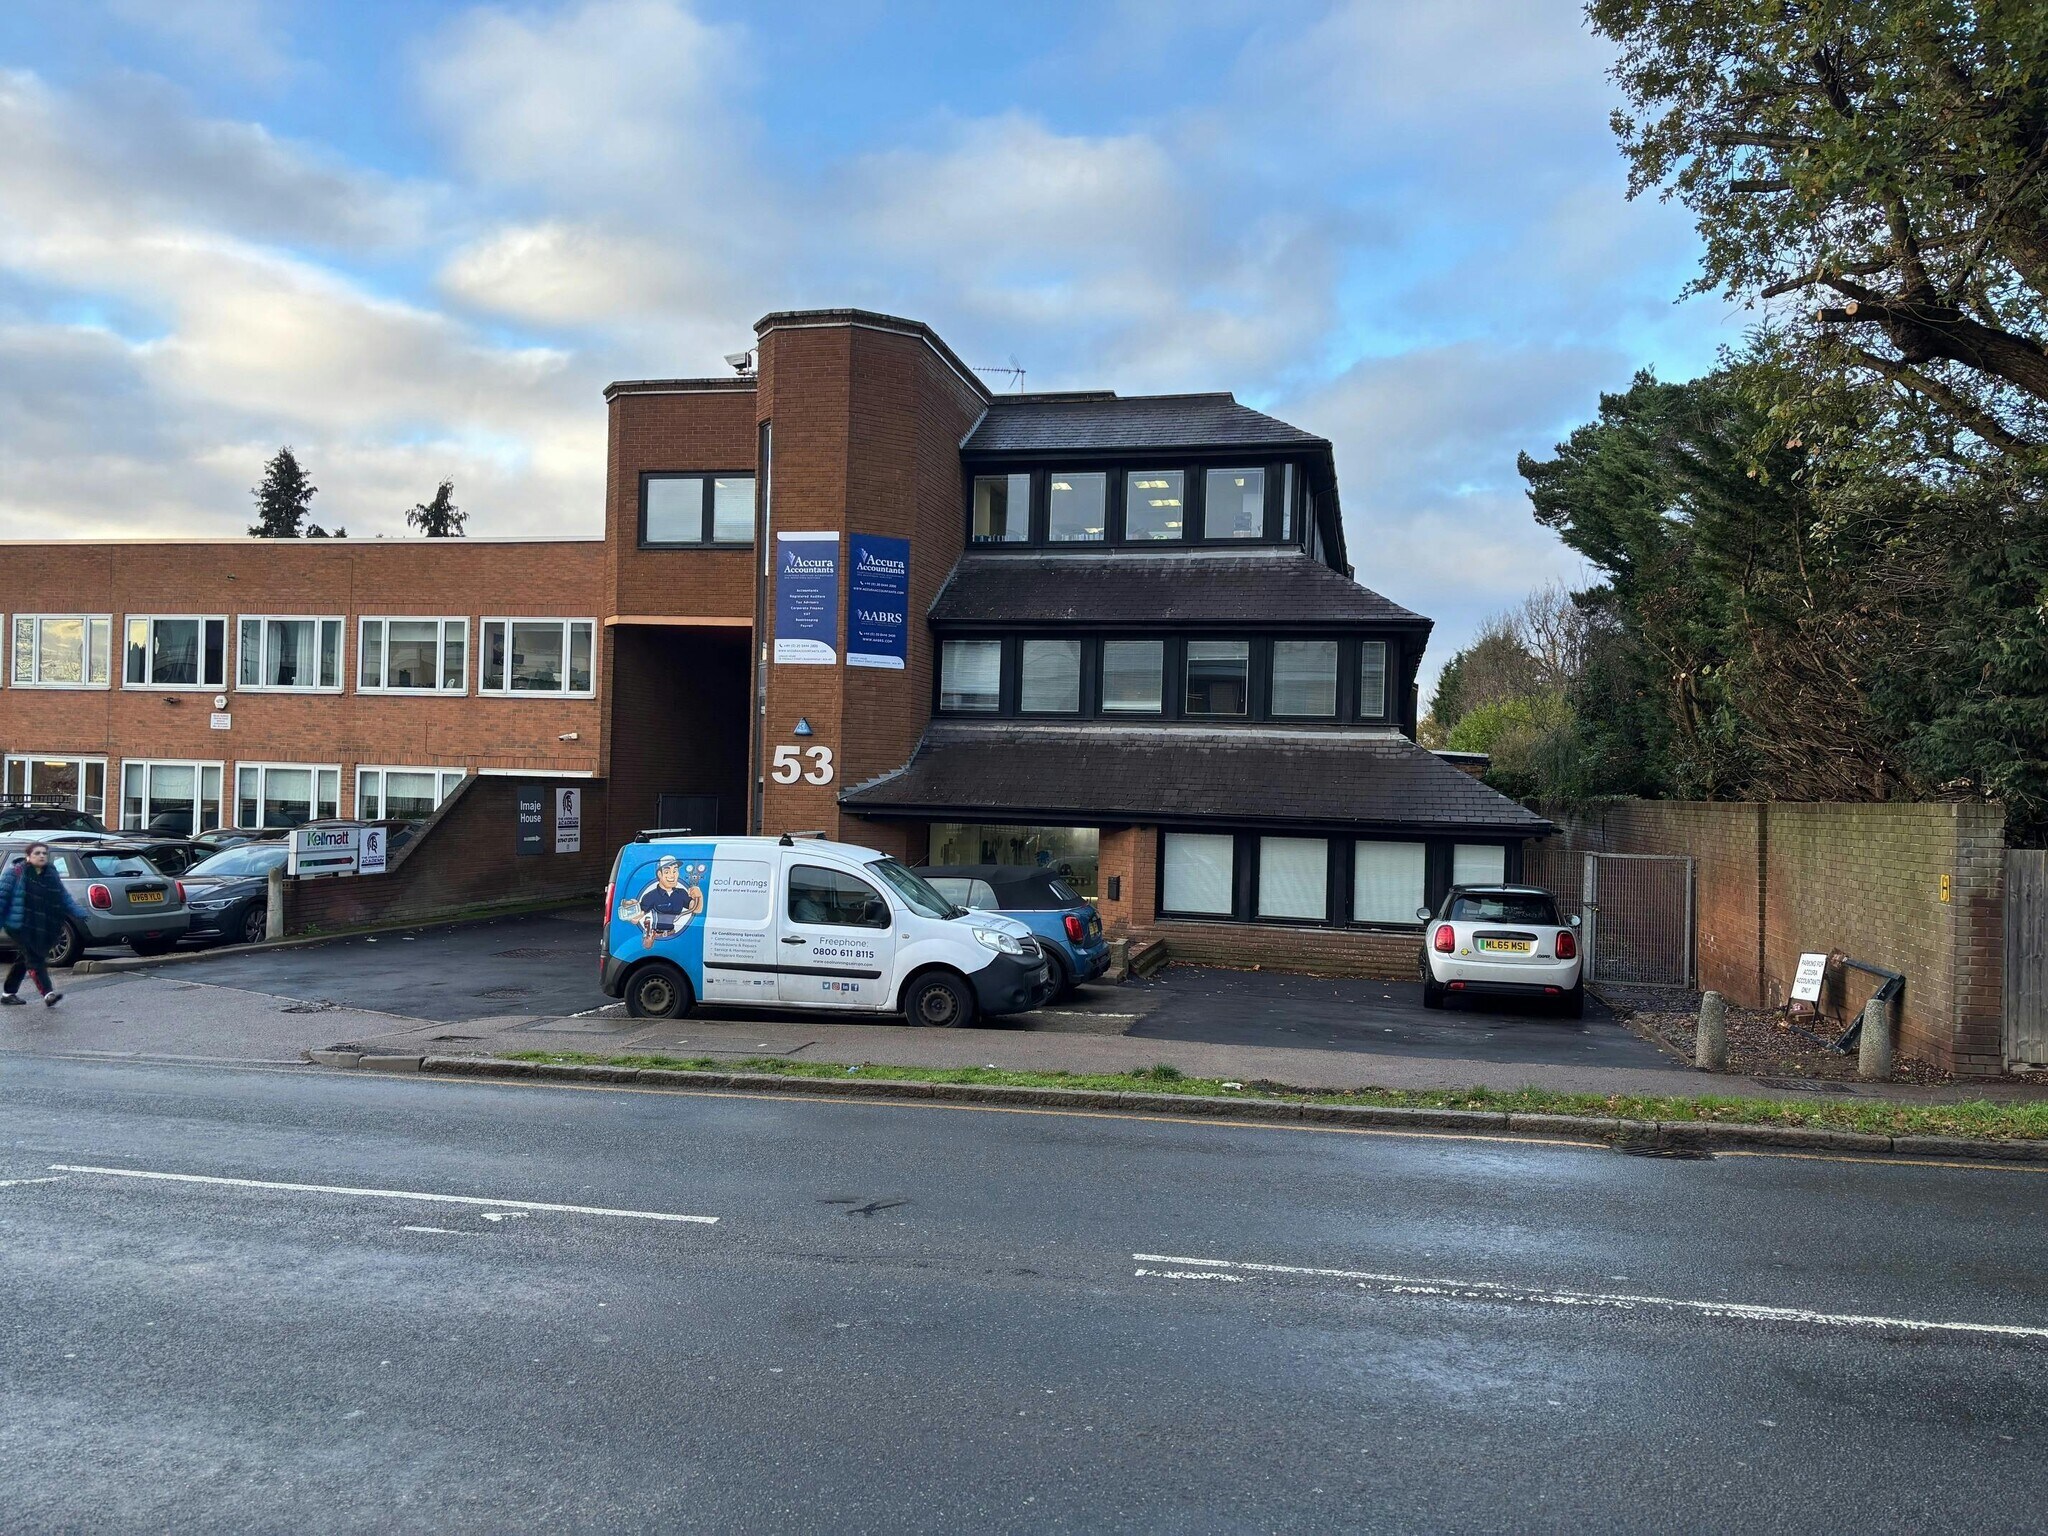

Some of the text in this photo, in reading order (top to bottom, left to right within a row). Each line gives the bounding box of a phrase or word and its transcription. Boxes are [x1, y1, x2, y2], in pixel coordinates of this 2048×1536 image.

[793, 556, 834, 567] Accura
[866, 554, 905, 569] Accura
[783, 565, 834, 573] Accountants
[856, 562, 905, 575] Accountants
[861, 610, 903, 624] AABRS
[771, 745, 834, 785] 53
[520, 800, 542, 813] Imaje
[520, 813, 542, 823] House
[307, 831, 349, 847] Kellmatt
[713, 876, 768, 889] cool runnings
[819, 936, 869, 948] Freephone:
[1485, 940, 1529, 951] ML65 MSL
[812, 947, 875, 959] 0800 611 8115
[1801, 959, 1817, 967] PARKING
